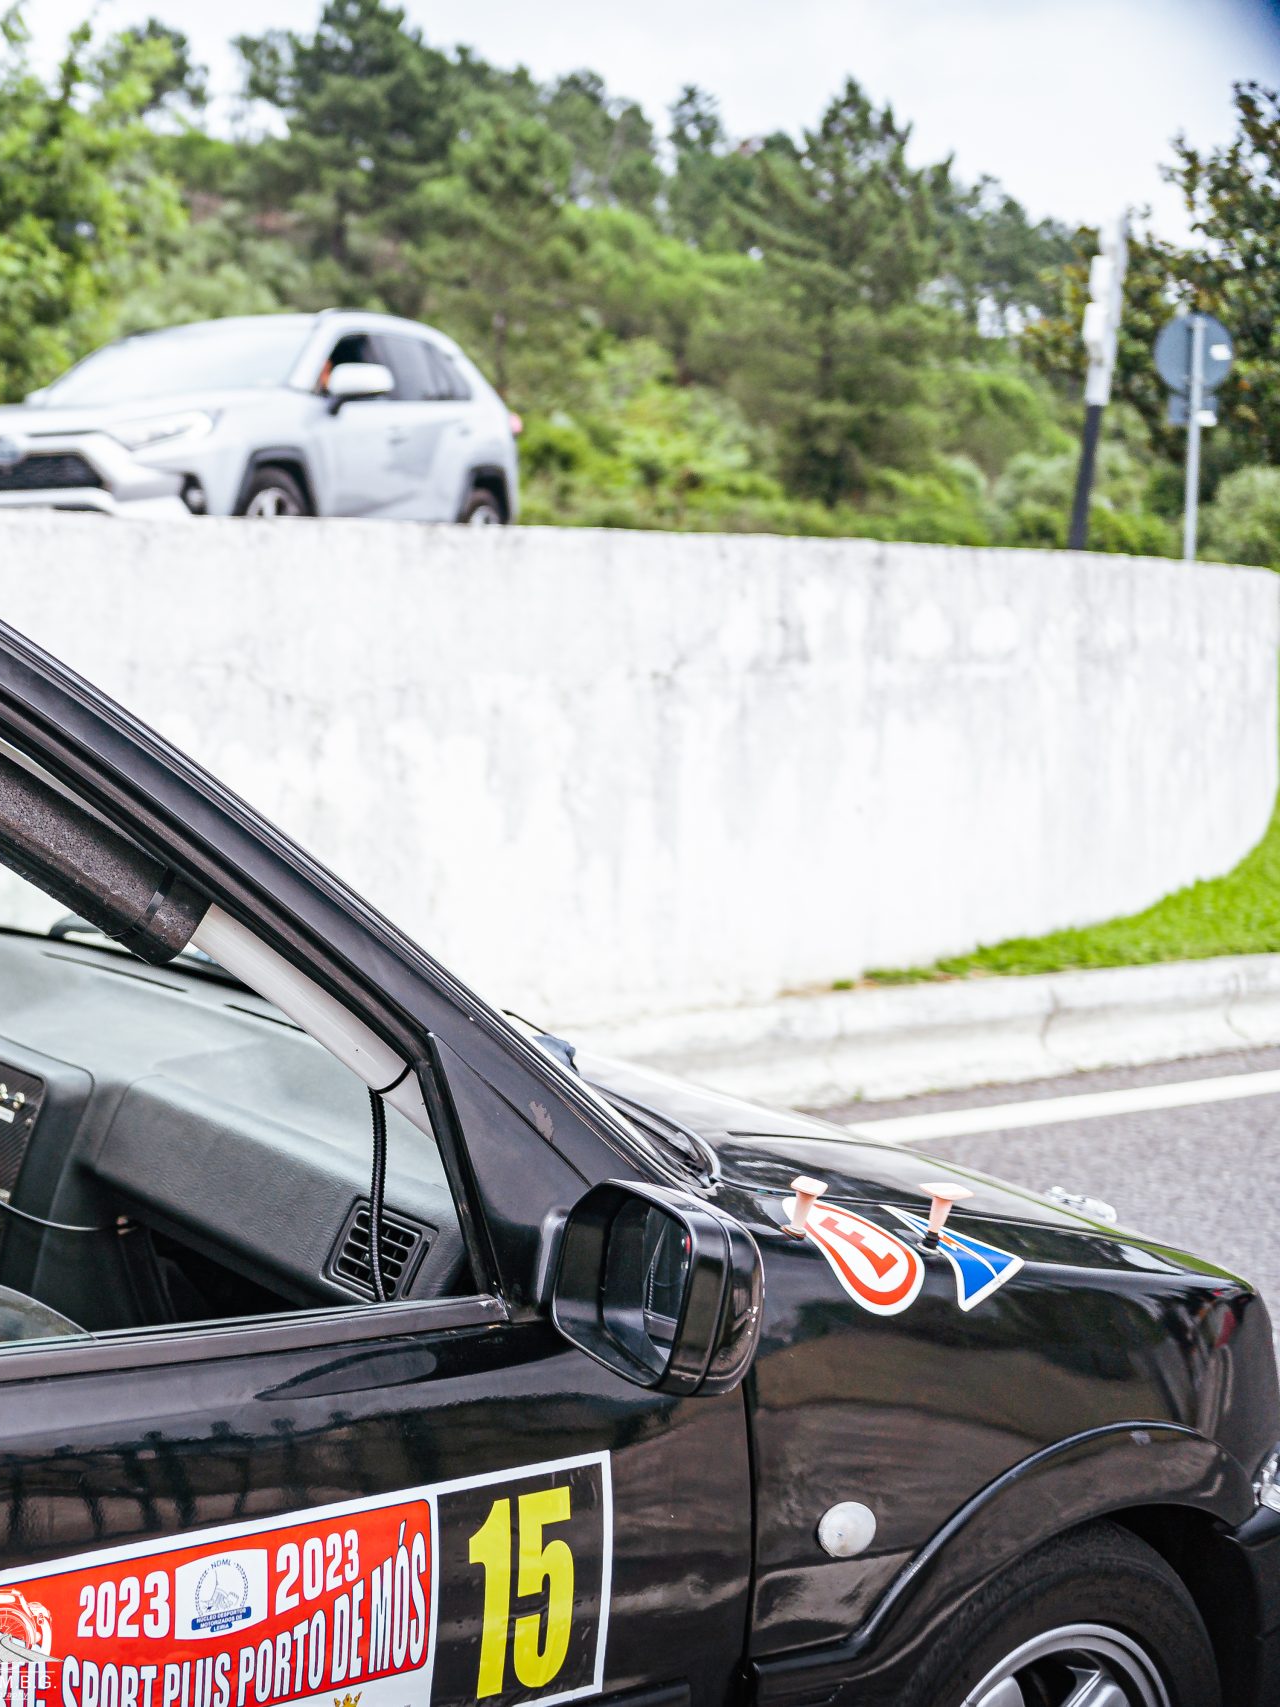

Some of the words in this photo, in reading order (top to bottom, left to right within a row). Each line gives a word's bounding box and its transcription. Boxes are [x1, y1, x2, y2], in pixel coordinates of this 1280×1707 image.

[818, 1216, 898, 1279] E
[62, 1655, 158, 1707] SPORT
[163, 1652, 231, 1707] PLUS
[237, 1609, 327, 1707] PORTO
[330, 1578, 365, 1684] DE
[369, 1519, 426, 1673] MÓS
[77, 1570, 171, 1638] 2023
[275, 1531, 360, 1615] 2023
[468, 1486, 575, 1699] 15
